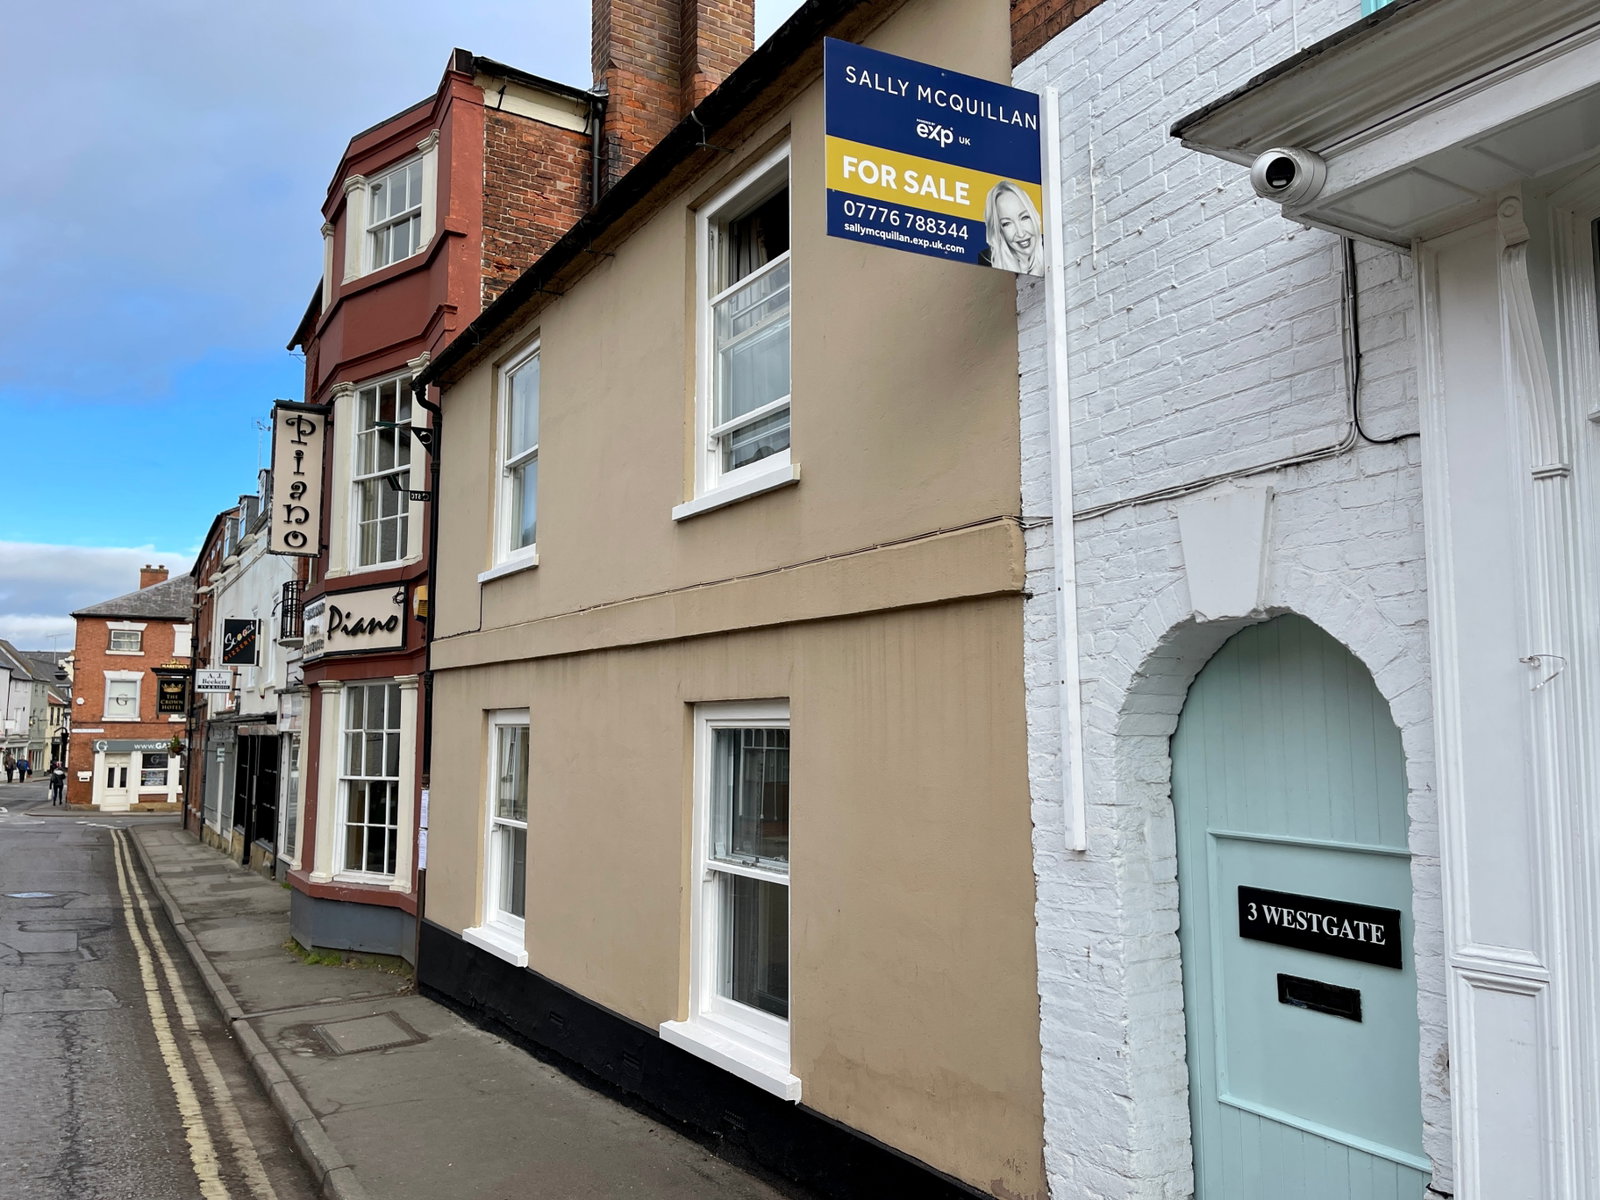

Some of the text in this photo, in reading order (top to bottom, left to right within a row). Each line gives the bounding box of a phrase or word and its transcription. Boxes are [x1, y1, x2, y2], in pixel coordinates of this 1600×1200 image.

[845, 66, 1037, 130] SALLY MCQUILLAN
[917, 123, 971, 147] exp UK
[843, 156, 970, 205] FOR SALE
[844, 200, 969, 240] 07776 788344
[844, 222, 965, 253] sallymcquillan.exp.uk.com
[283, 415, 316, 548] Piano
[327, 605, 398, 640] Piano
[116, 694, 128, 707] G
[96, 740, 108, 752] G
[1247, 902, 1386, 945] 3 WESTGATE
